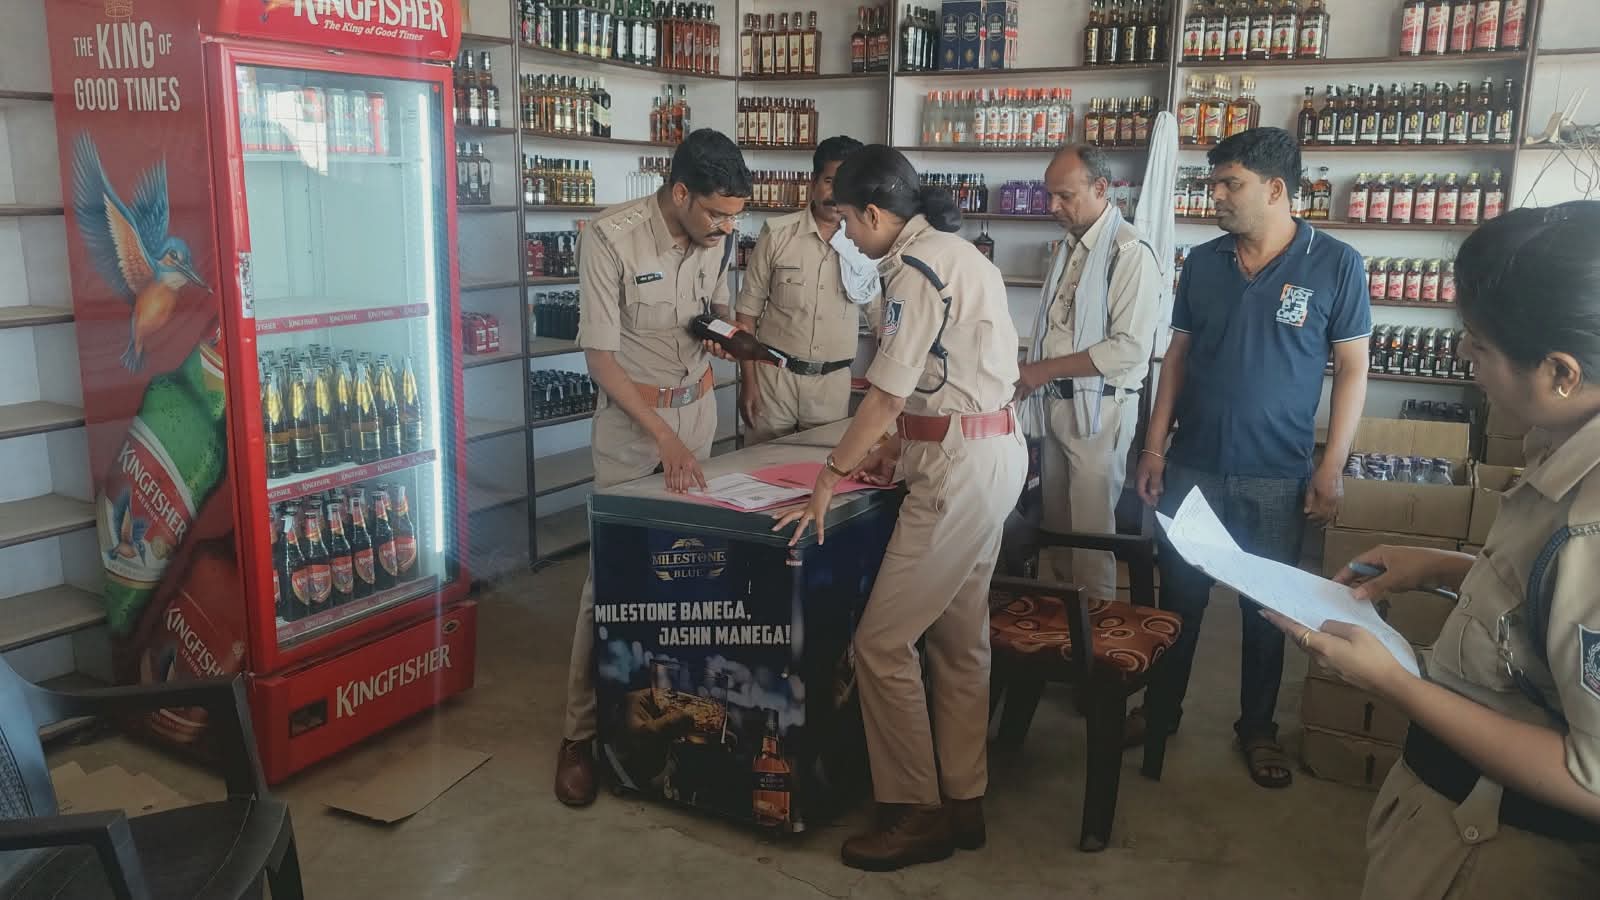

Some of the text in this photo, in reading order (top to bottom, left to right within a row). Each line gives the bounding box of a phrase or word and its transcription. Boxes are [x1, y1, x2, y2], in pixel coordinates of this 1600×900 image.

[323, 20, 424, 41] The King of Good Times
[73, 21, 172, 69] THE KING OF
[74, 76, 180, 112] GOOD TIMES
[117, 440, 188, 545] KINGFISHER
[652, 551, 727, 566] MILESTONE
[673, 568, 704, 579] BLUE
[594, 600, 752, 623] MILESTONE BANEGA,
[658, 624, 792, 646] JASHN MANEGA!
[336, 644, 453, 719] KINGFISHER
